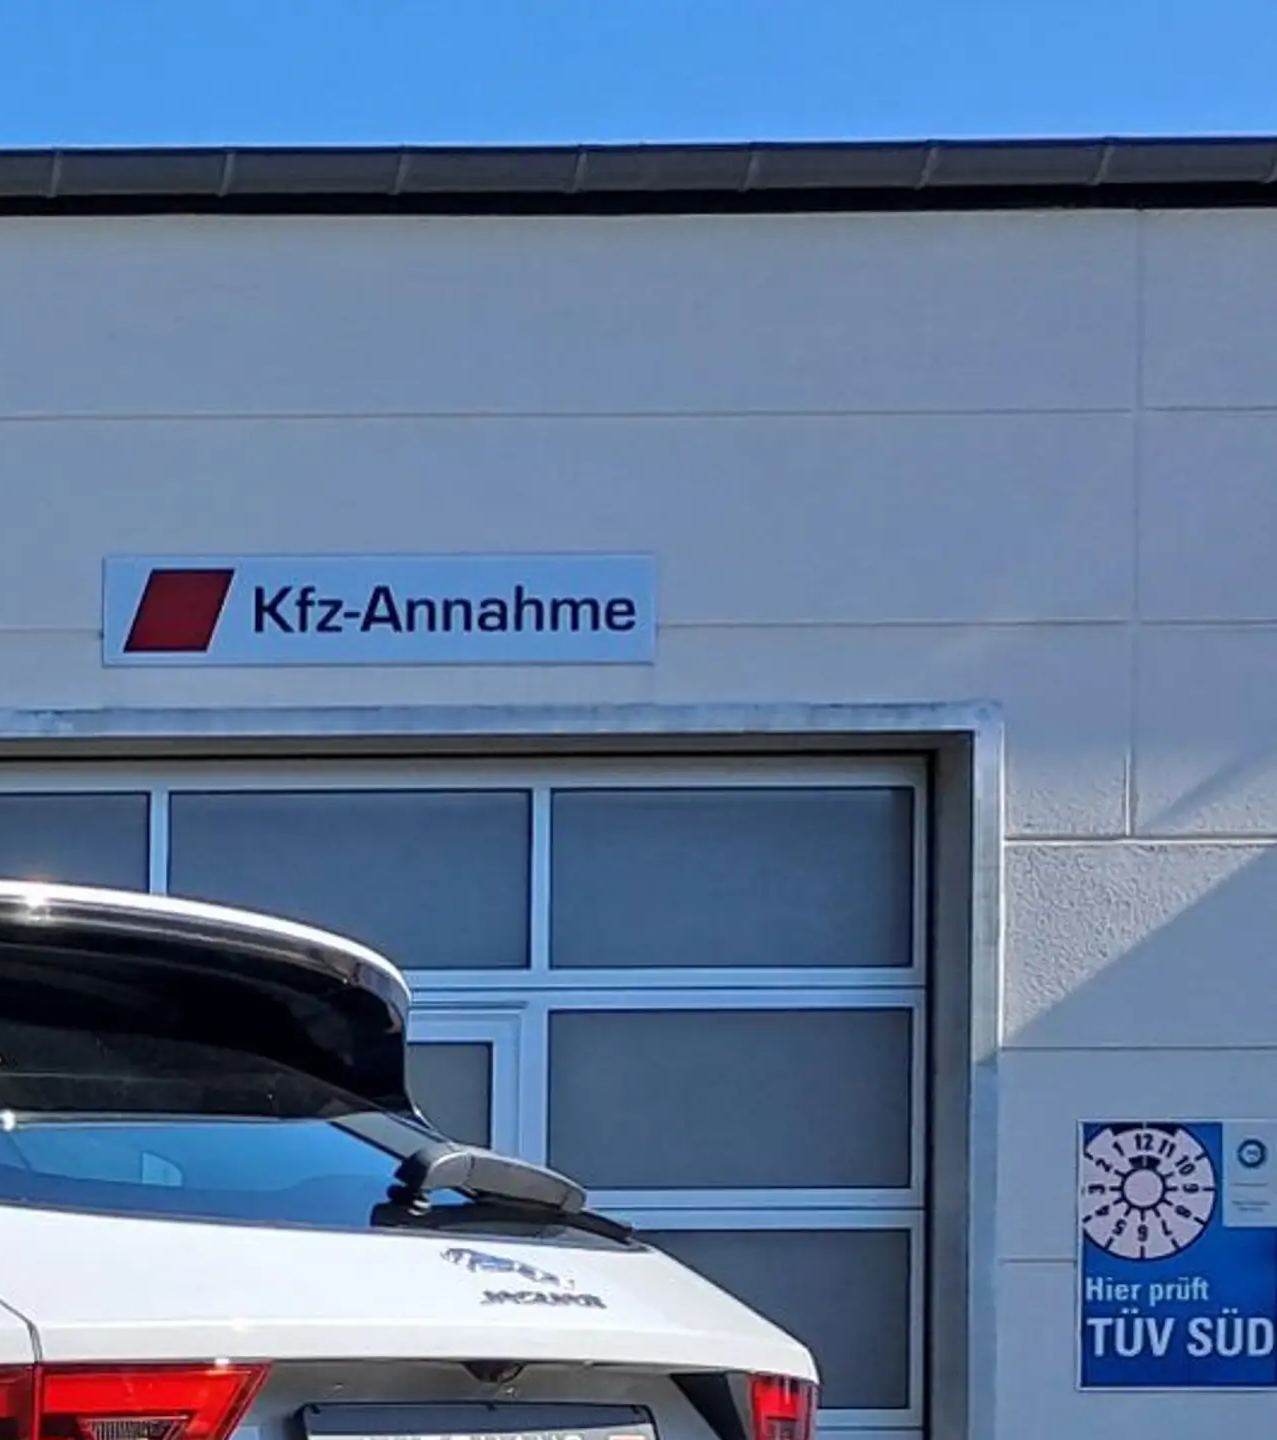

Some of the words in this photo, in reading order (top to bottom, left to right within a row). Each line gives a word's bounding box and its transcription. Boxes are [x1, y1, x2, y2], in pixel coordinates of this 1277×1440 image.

[254, 584, 637, 633] Kfz-Annahme
[1112, 1141, 1125, 1157] 1
[1134, 1133, 1154, 1151] 12
[1158, 1139, 1176, 1158] 11
[1095, 1158, 1112, 1173] 2
[1175, 1155, 1195, 1176] 10
[1088, 1184, 1106, 1195] 3
[1182, 1183, 1199, 1194] 9
[1095, 1205, 1110, 1216] 4
[1175, 1205, 1192, 1218] 8
[1112, 1219, 1127, 1236] 5
[1137, 1224, 1148, 1242] 6
[1161, 1219, 1173, 1236] 7
[1085, 1276, 1142, 1301] Hier
[1149, 1276, 1210, 1307] prüft
[1086, 1307, 1176, 1358] TÜV
[1186, 1307, 1274, 1358] SÜD
